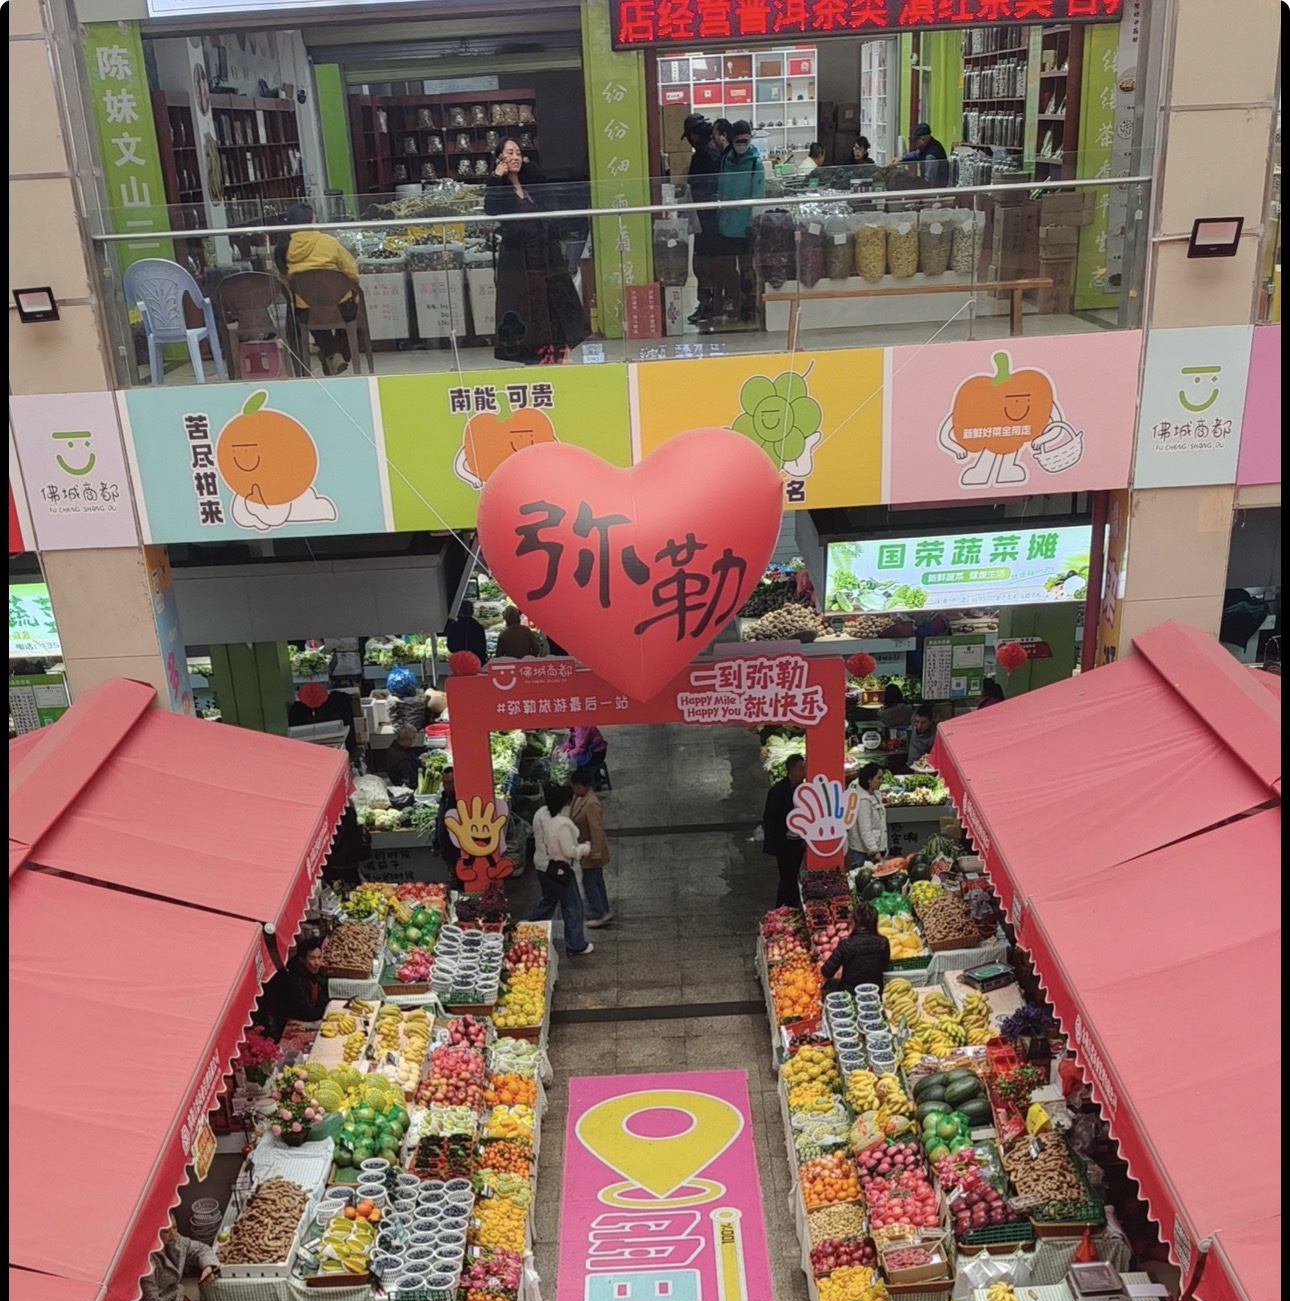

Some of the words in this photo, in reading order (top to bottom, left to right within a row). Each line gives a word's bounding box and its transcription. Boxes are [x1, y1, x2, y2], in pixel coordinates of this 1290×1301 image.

[1152, 417, 1233, 443] 佛城商都
[184, 415, 225, 525] 苦尽柑来
[41, 482, 119, 505] 佛城商都
[786, 481, 806, 503] 名
[877, 532, 1060, 570] 国荣蔬菜摊
[514, 500, 747, 642] 弥勒
[519, 664, 573, 678] 佛城商都
[694, 660, 804, 691] 一到弥勒
[497, 695, 629, 716] #弥勒旅游最后一站
[681, 695, 712, 707] Happy
[714, 696, 737, 705] Mile
[688, 706, 718, 718] Happy
[721, 706, 741, 718] You
[744, 690, 824, 721] 就快乐
[720, 1222, 735, 1244] 100%
